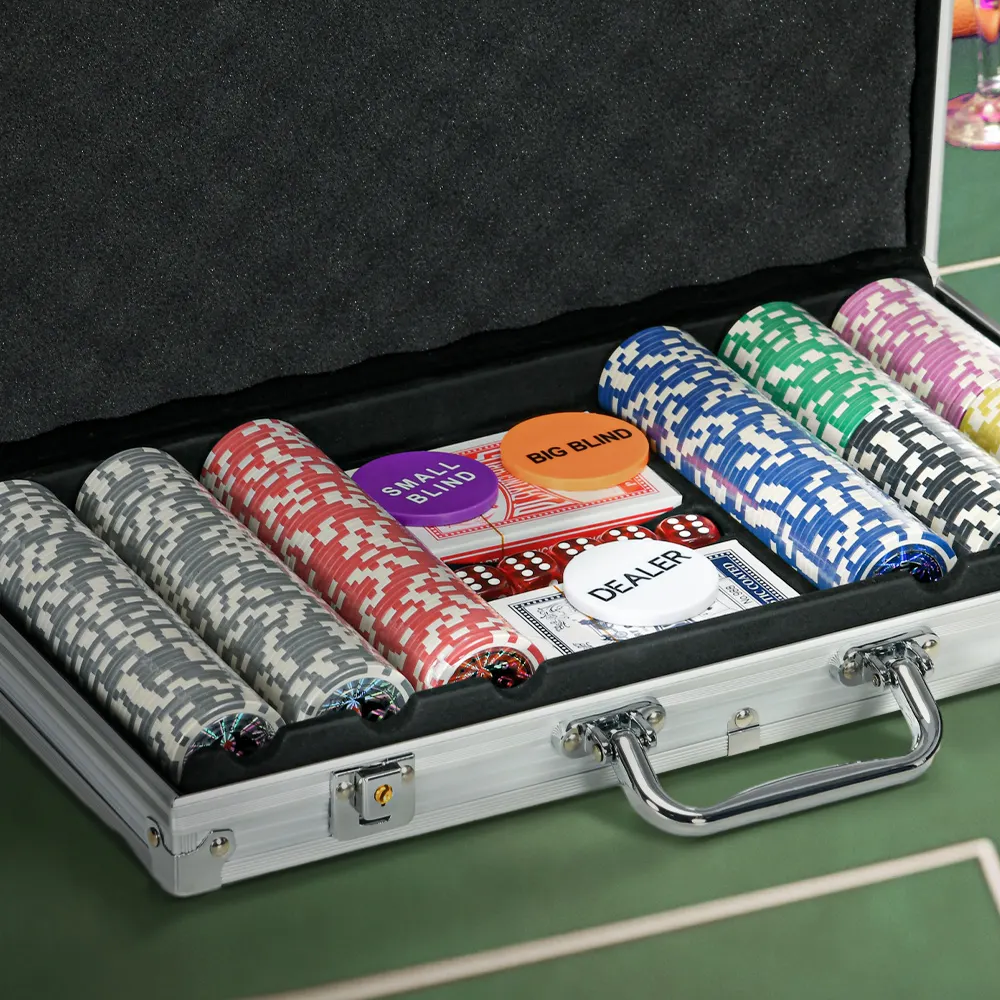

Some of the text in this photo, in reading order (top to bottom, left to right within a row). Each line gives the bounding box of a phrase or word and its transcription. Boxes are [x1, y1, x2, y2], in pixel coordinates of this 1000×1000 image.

[526, 447, 568, 464] BIG
[566, 428, 633, 452] BLIND
[381, 462, 461, 496] SMALL
[405, 471, 476, 504] BLIND
[587, 550, 692, 602] DEALER
[722, 562, 759, 590] COATED
